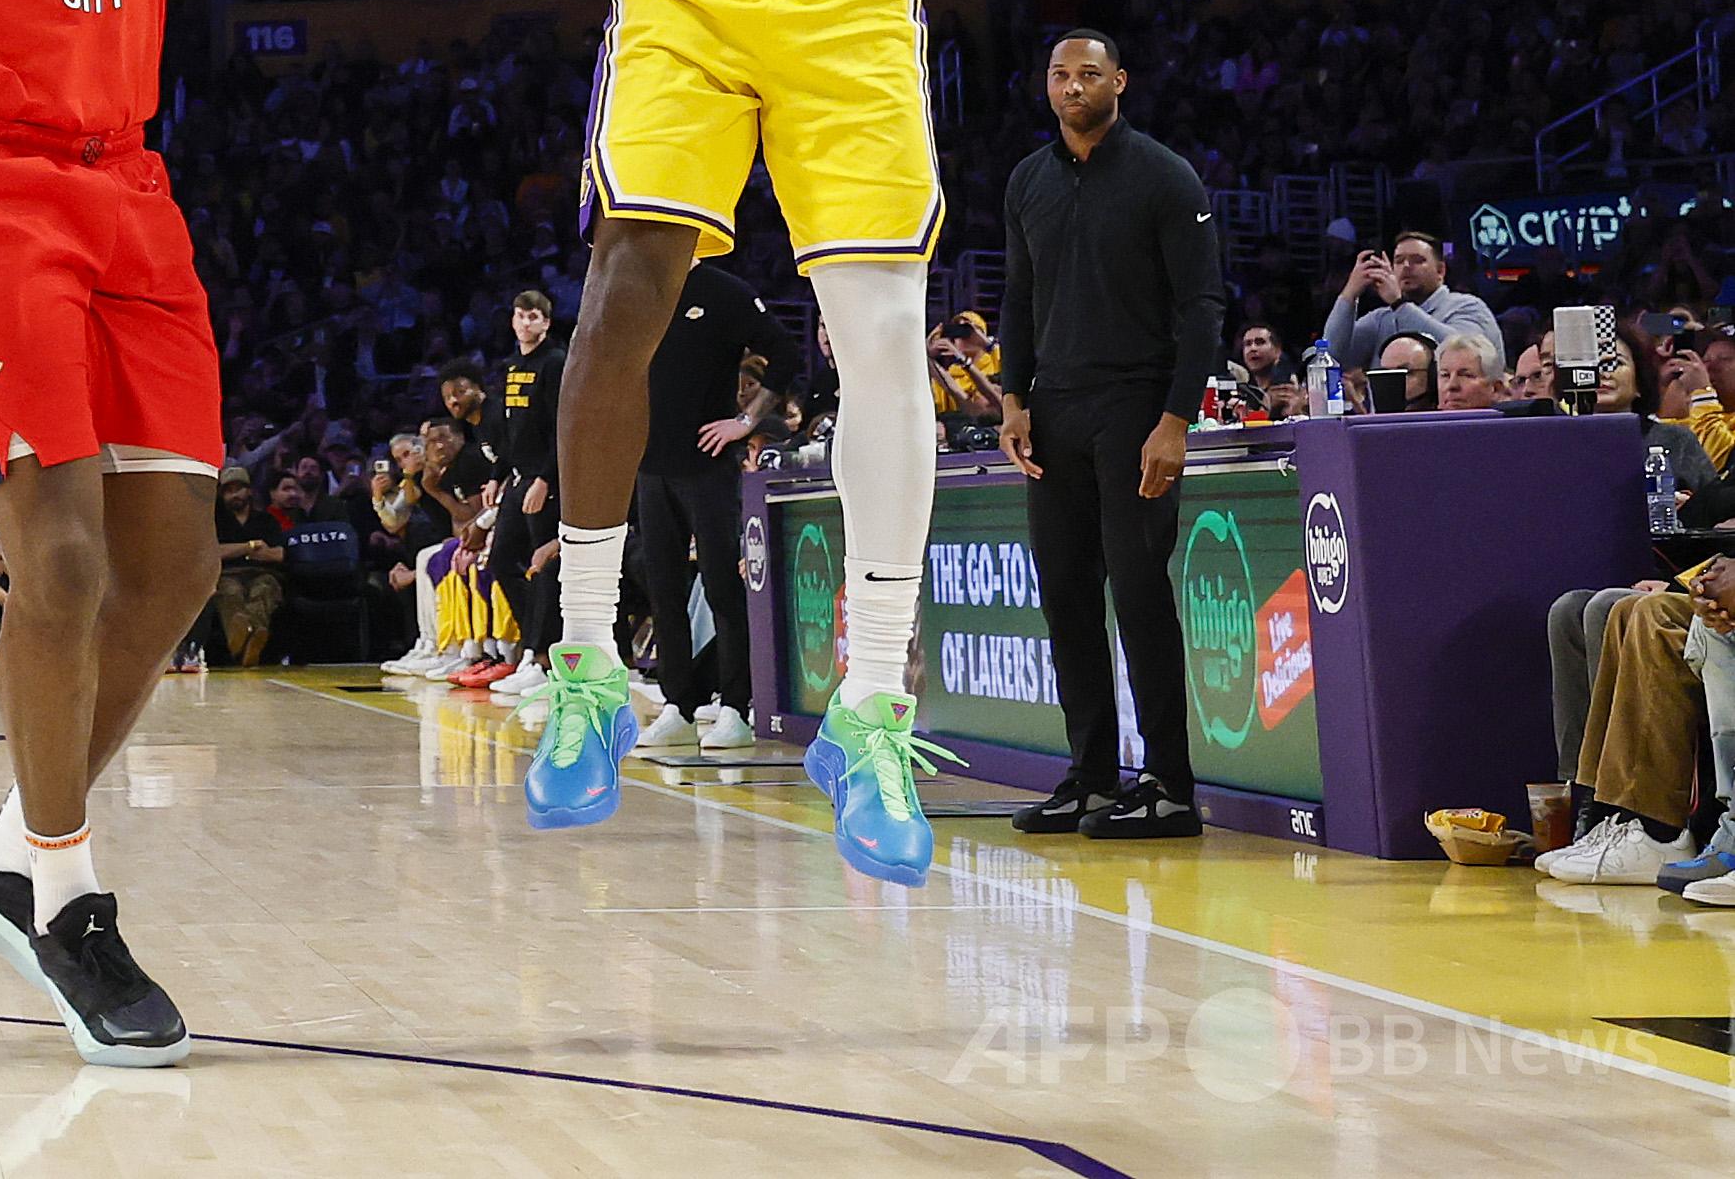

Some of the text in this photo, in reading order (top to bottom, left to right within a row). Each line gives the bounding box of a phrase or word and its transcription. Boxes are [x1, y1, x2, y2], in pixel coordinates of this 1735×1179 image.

[301, 532, 347, 544] DELTA
[1309, 525, 1344, 577] bibigo
[930, 544, 964, 604] THE
[966, 543, 1026, 607] GO-TO
[1188, 575, 1252, 678] bibigo
[941, 631, 964, 694] OF
[967, 633, 1038, 704] LAKERS
